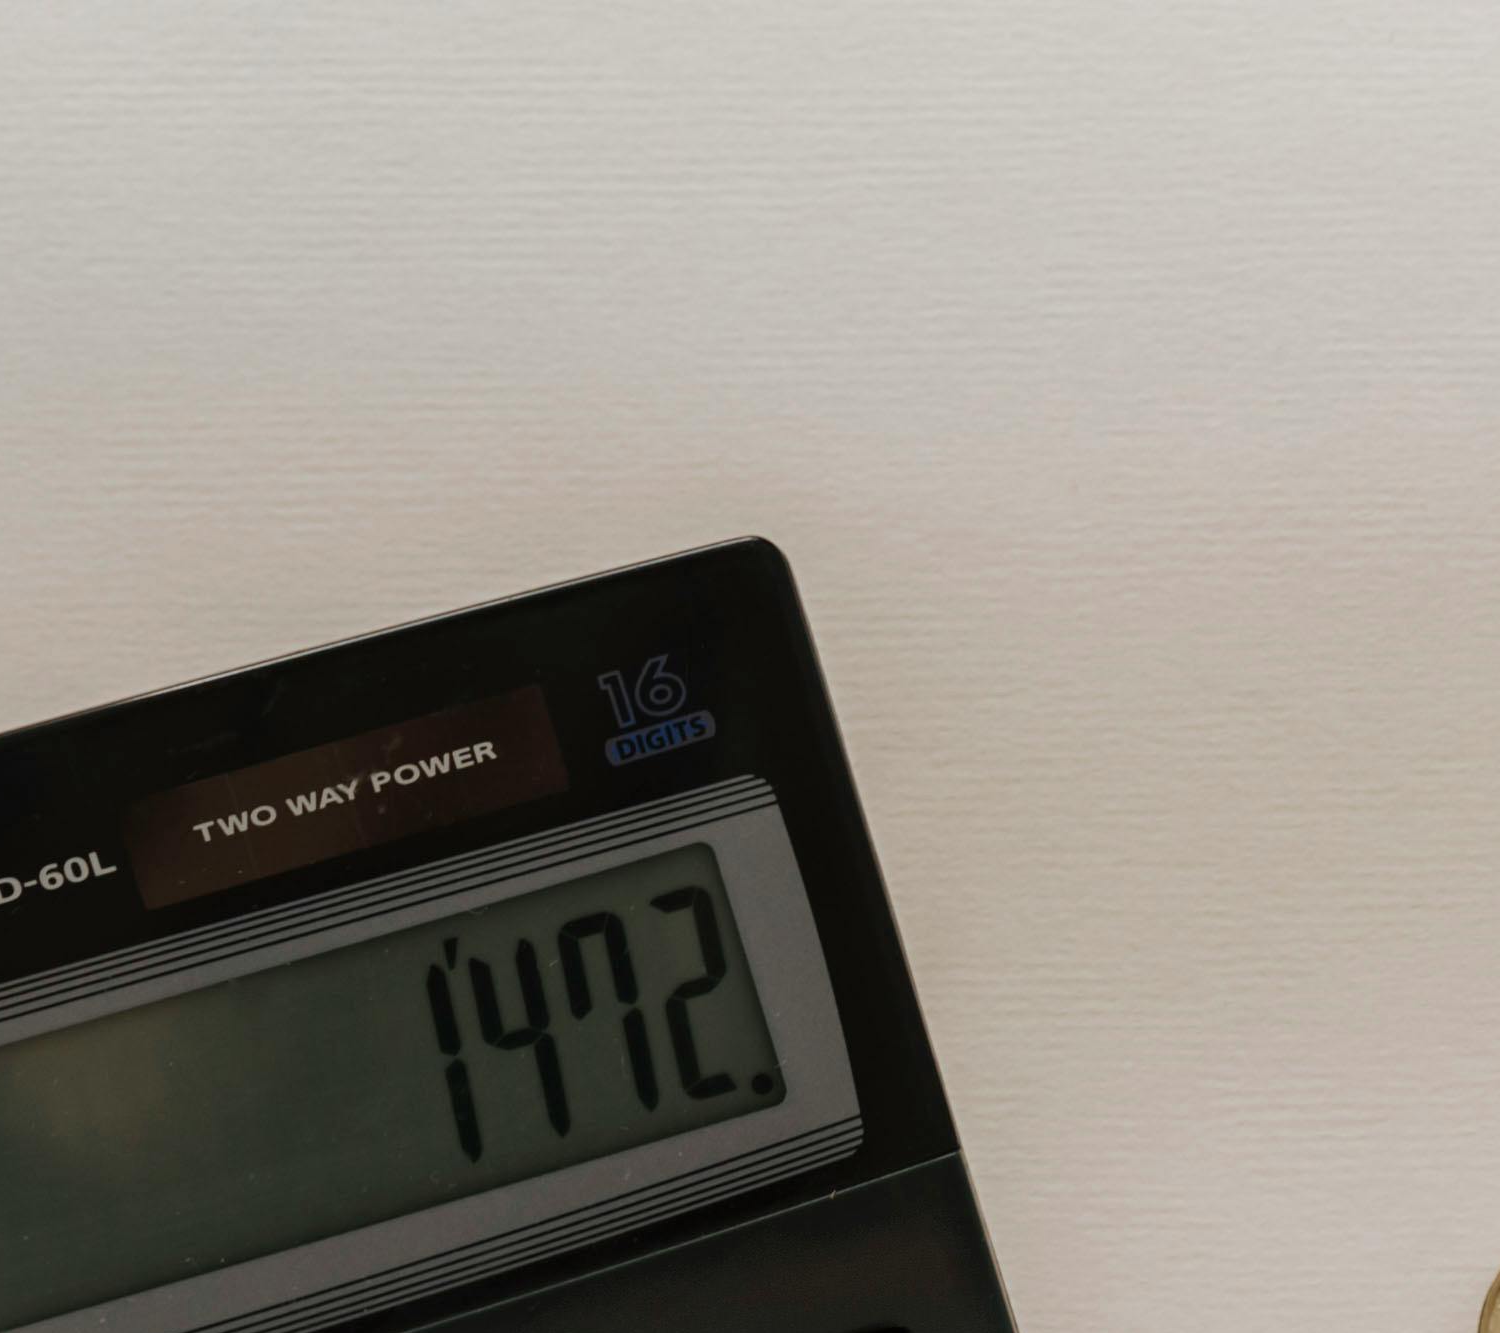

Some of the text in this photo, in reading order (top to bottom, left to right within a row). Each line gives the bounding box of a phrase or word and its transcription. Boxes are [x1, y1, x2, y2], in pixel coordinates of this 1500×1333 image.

[596, 653, 688, 728] 16
[614, 711, 709, 763] DIGITS
[192, 741, 498, 842] TWO WAY POWER
